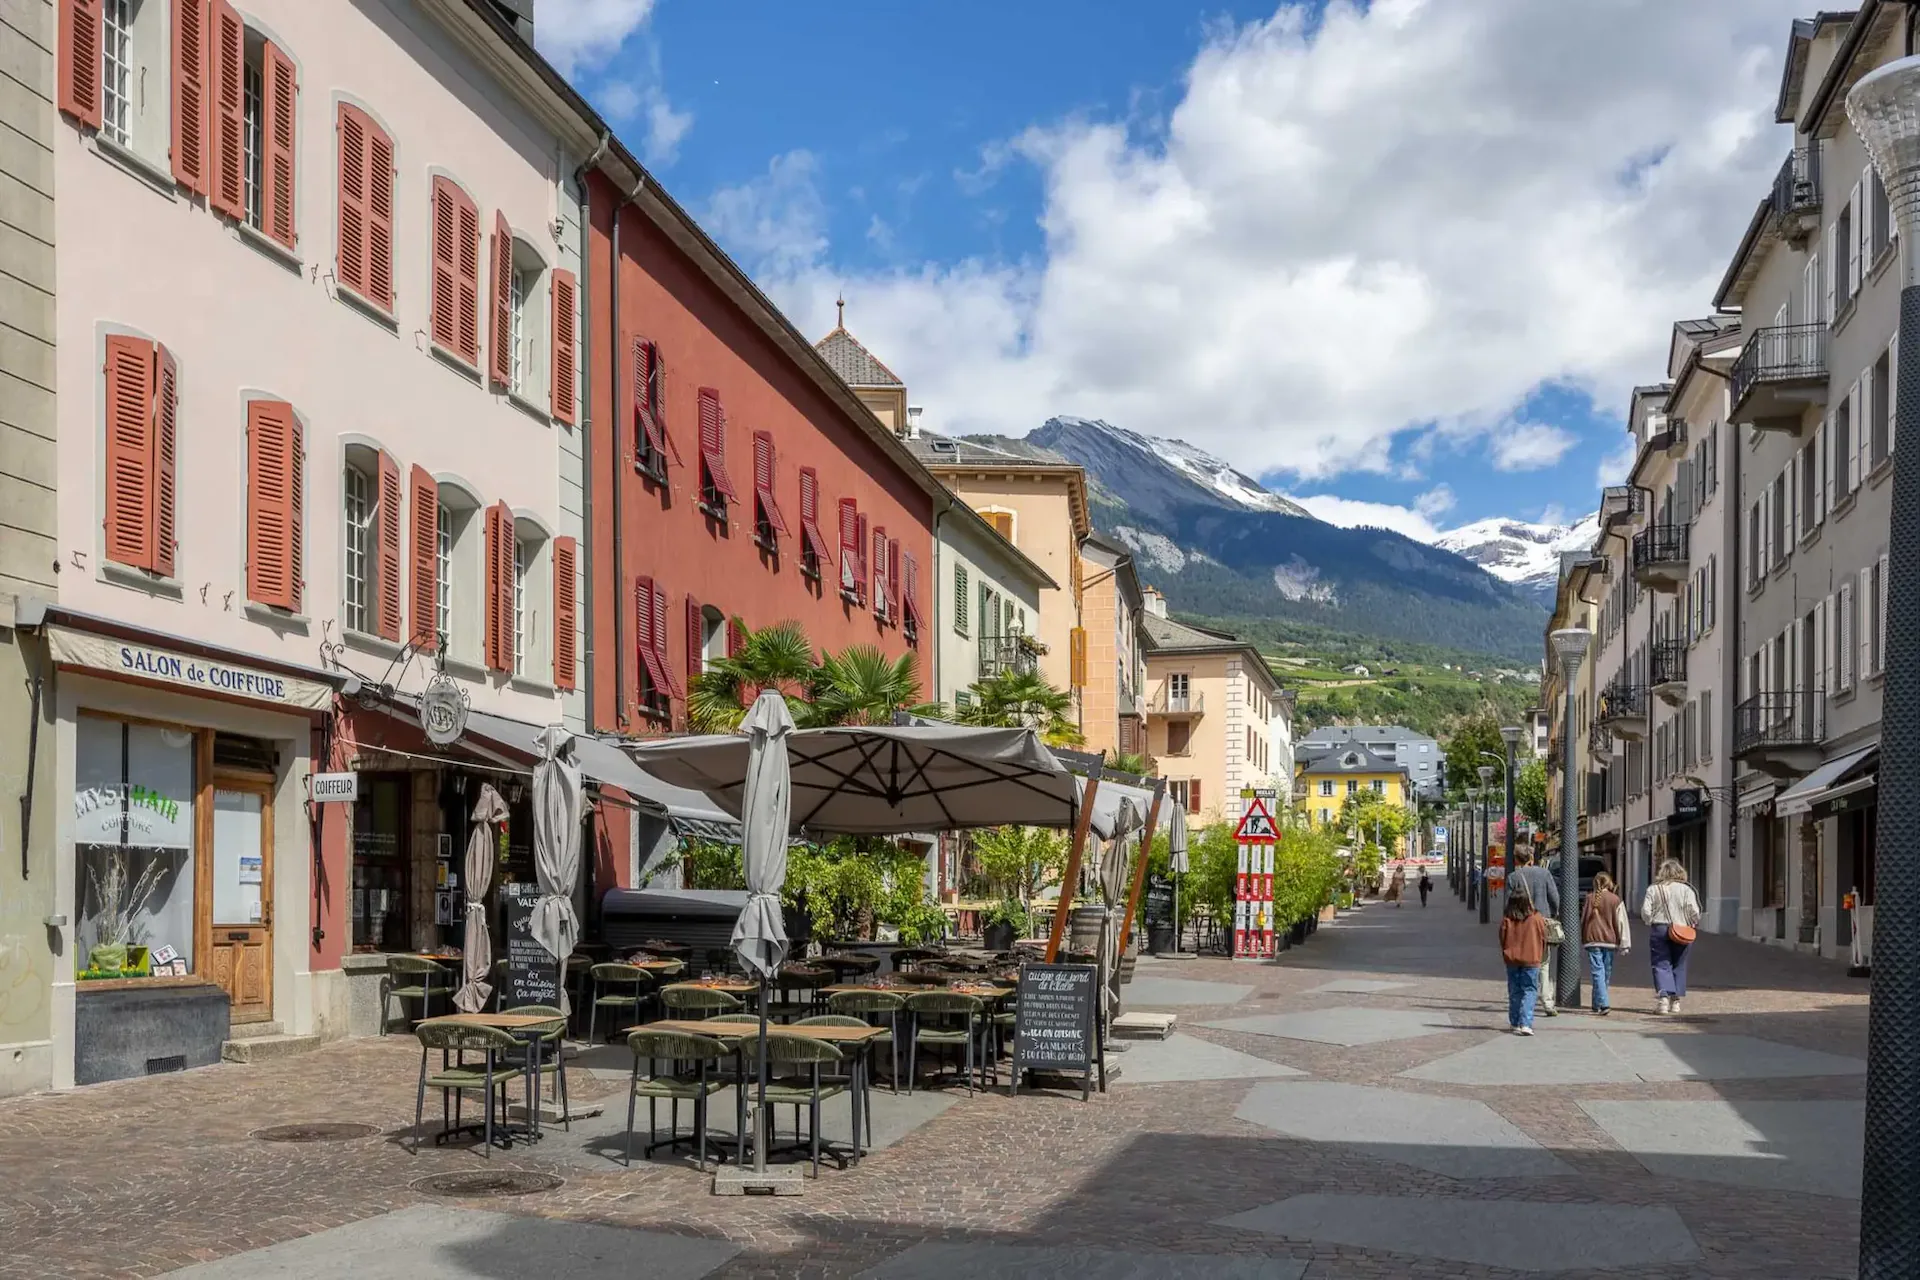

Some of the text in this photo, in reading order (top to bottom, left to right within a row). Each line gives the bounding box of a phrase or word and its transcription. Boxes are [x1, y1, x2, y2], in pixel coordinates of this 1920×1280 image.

[121, 648, 285, 698] SALON de COIFFURE
[315, 779, 352, 794] COIFFEUR
[517, 898, 539, 907] VALS
